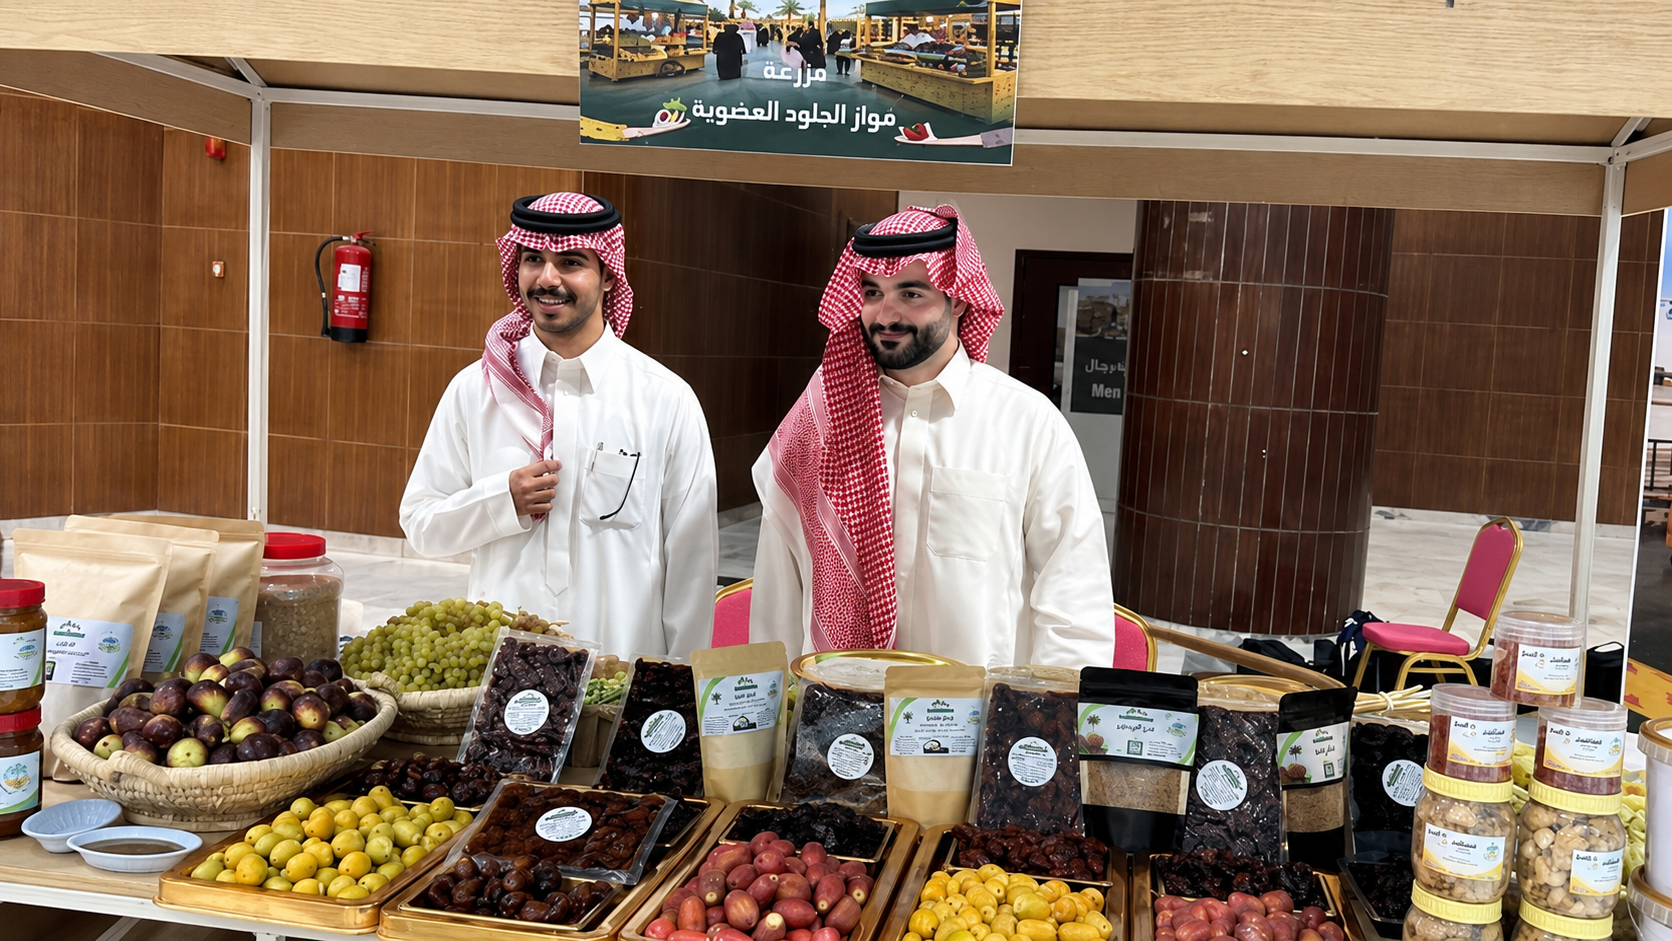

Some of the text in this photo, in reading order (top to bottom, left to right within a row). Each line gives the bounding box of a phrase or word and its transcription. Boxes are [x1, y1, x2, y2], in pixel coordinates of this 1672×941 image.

[763, 61, 827, 88] مزرعة
[692, 99, 779, 126] العضوية
[785, 102, 847, 130] الجلود
[1091, 383, 1121, 399] Men
